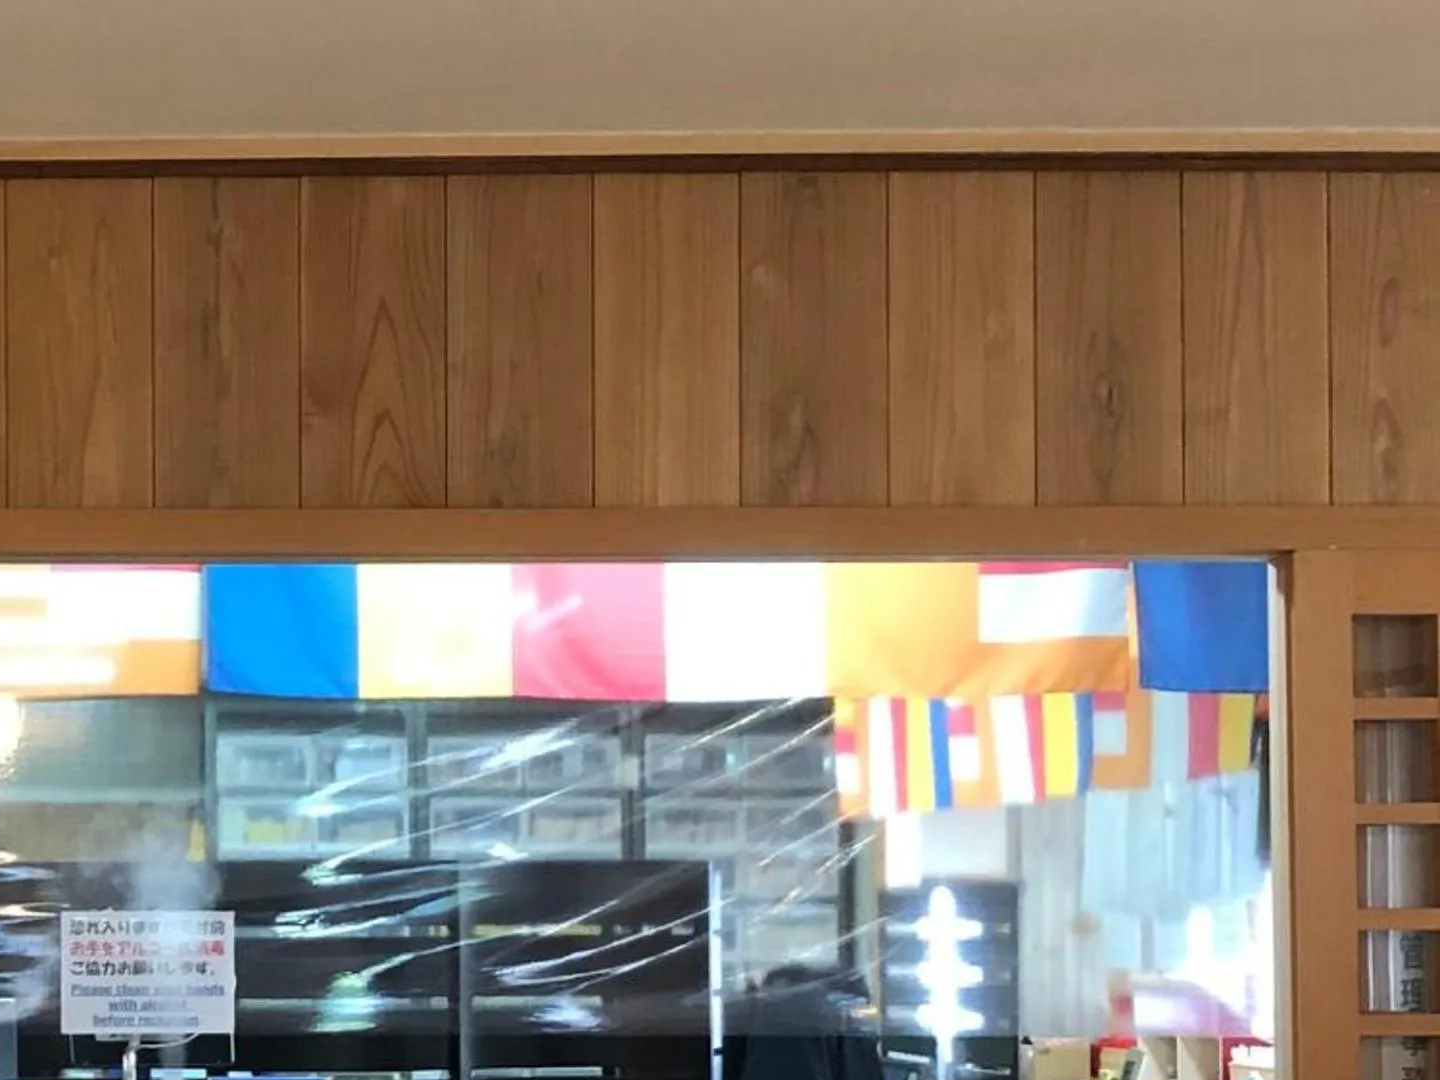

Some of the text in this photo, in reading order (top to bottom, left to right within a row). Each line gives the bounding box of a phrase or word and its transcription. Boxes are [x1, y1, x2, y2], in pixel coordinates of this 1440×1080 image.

[70, 919, 225, 935] 恐れ入ります付前
[140, 999, 187, 1011] alcl
